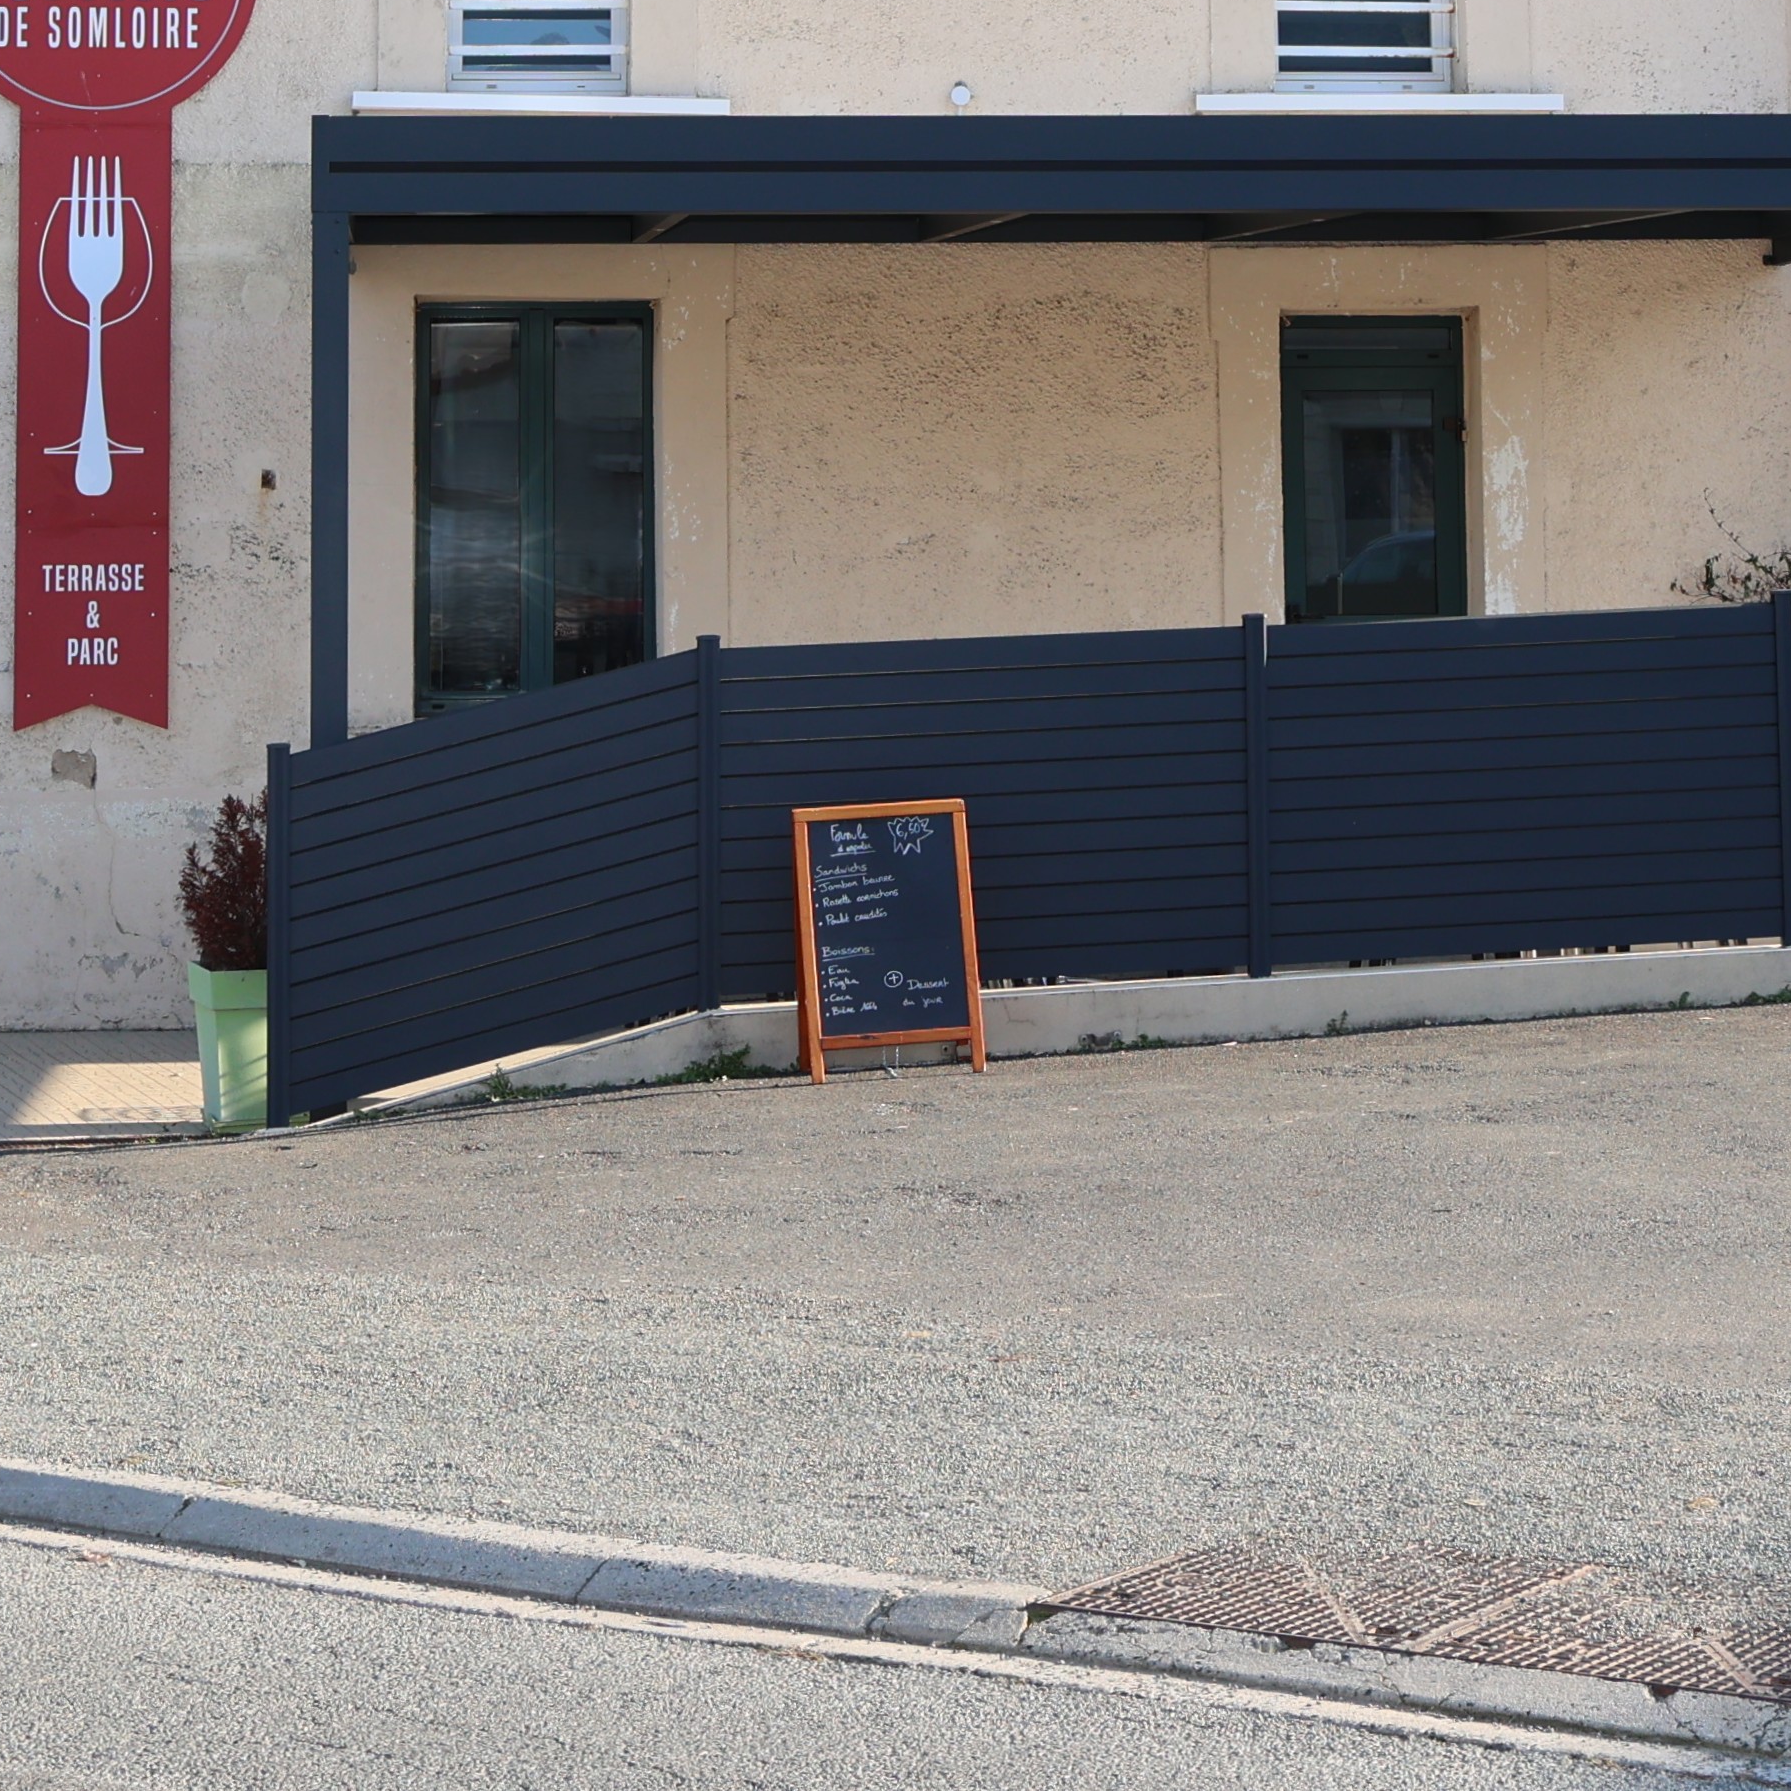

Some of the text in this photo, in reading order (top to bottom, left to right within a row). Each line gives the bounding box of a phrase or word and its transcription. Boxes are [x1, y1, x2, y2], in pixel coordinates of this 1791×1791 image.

[47, 6, 199, 49] SOMLOIRE
[42, 564, 145, 593] TERRASSE
[86, 600, 101, 630] &
[67, 637, 119, 666] PARC
[830, 823, 869, 842] Formule
[818, 880, 858, 893] Jambon
[827, 964, 850, 975] Eau
[907, 977, 950, 991] Dessert
[829, 993, 853, 1002] Coca
